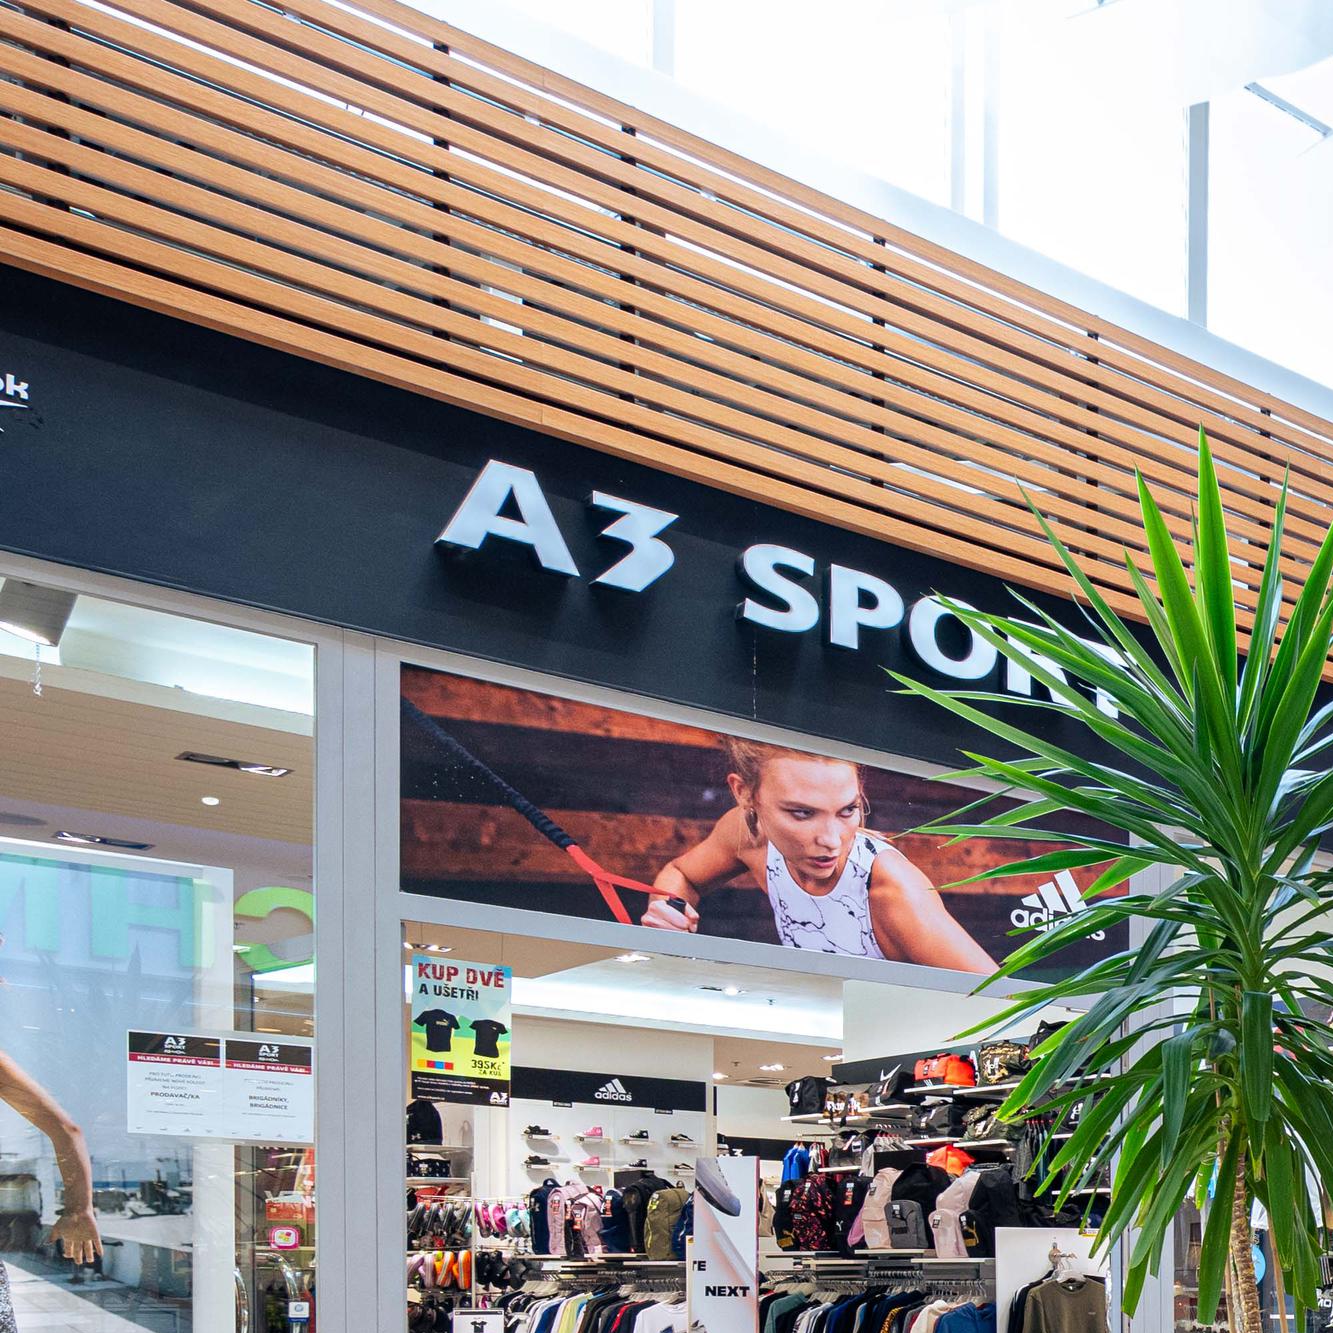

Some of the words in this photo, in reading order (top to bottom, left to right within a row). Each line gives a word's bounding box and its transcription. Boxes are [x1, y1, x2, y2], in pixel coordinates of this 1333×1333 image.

[434, 458, 681, 594] A3
[735, 543, 1138, 720] SPOR
[417, 962, 459, 982] KUP
[465, 966, 505, 989] DVĚ
[419, 983, 428, 996] A
[433, 984, 479, 1001] UŠETŘI
[164, 1036, 187, 1046] A3
[258, 1044, 280, 1053] A3
[594, 1090, 632, 1102] adidas
[705, 1286, 750, 1297] NEXT
